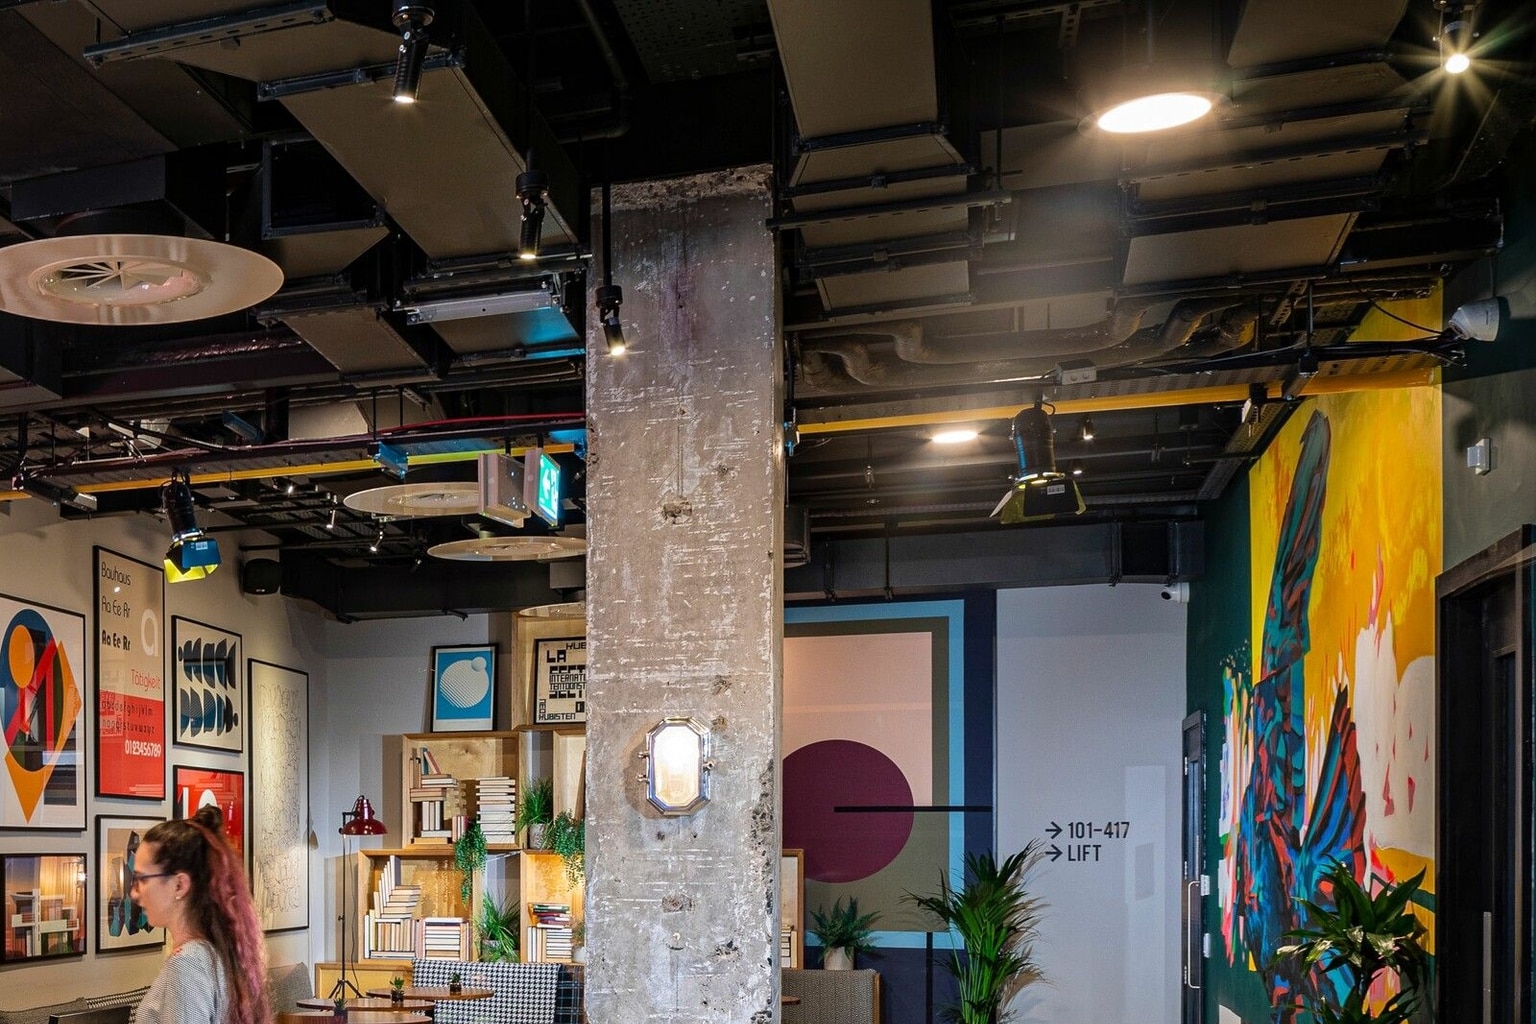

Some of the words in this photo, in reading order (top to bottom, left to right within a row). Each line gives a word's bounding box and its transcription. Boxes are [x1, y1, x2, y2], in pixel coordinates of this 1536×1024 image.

[101, 561, 131, 586] Bauhaus
[101, 595, 111, 613] Aa
[112, 599, 122, 617] Ee
[101, 629, 111, 646] Aa
[112, 632, 122, 649] Ee
[547, 650, 566, 663] LA
[124, 739, 162, 758] 0123456789
[1068, 821, 1130, 839] 101-417
[1068, 844, 1102, 861] LIFT
